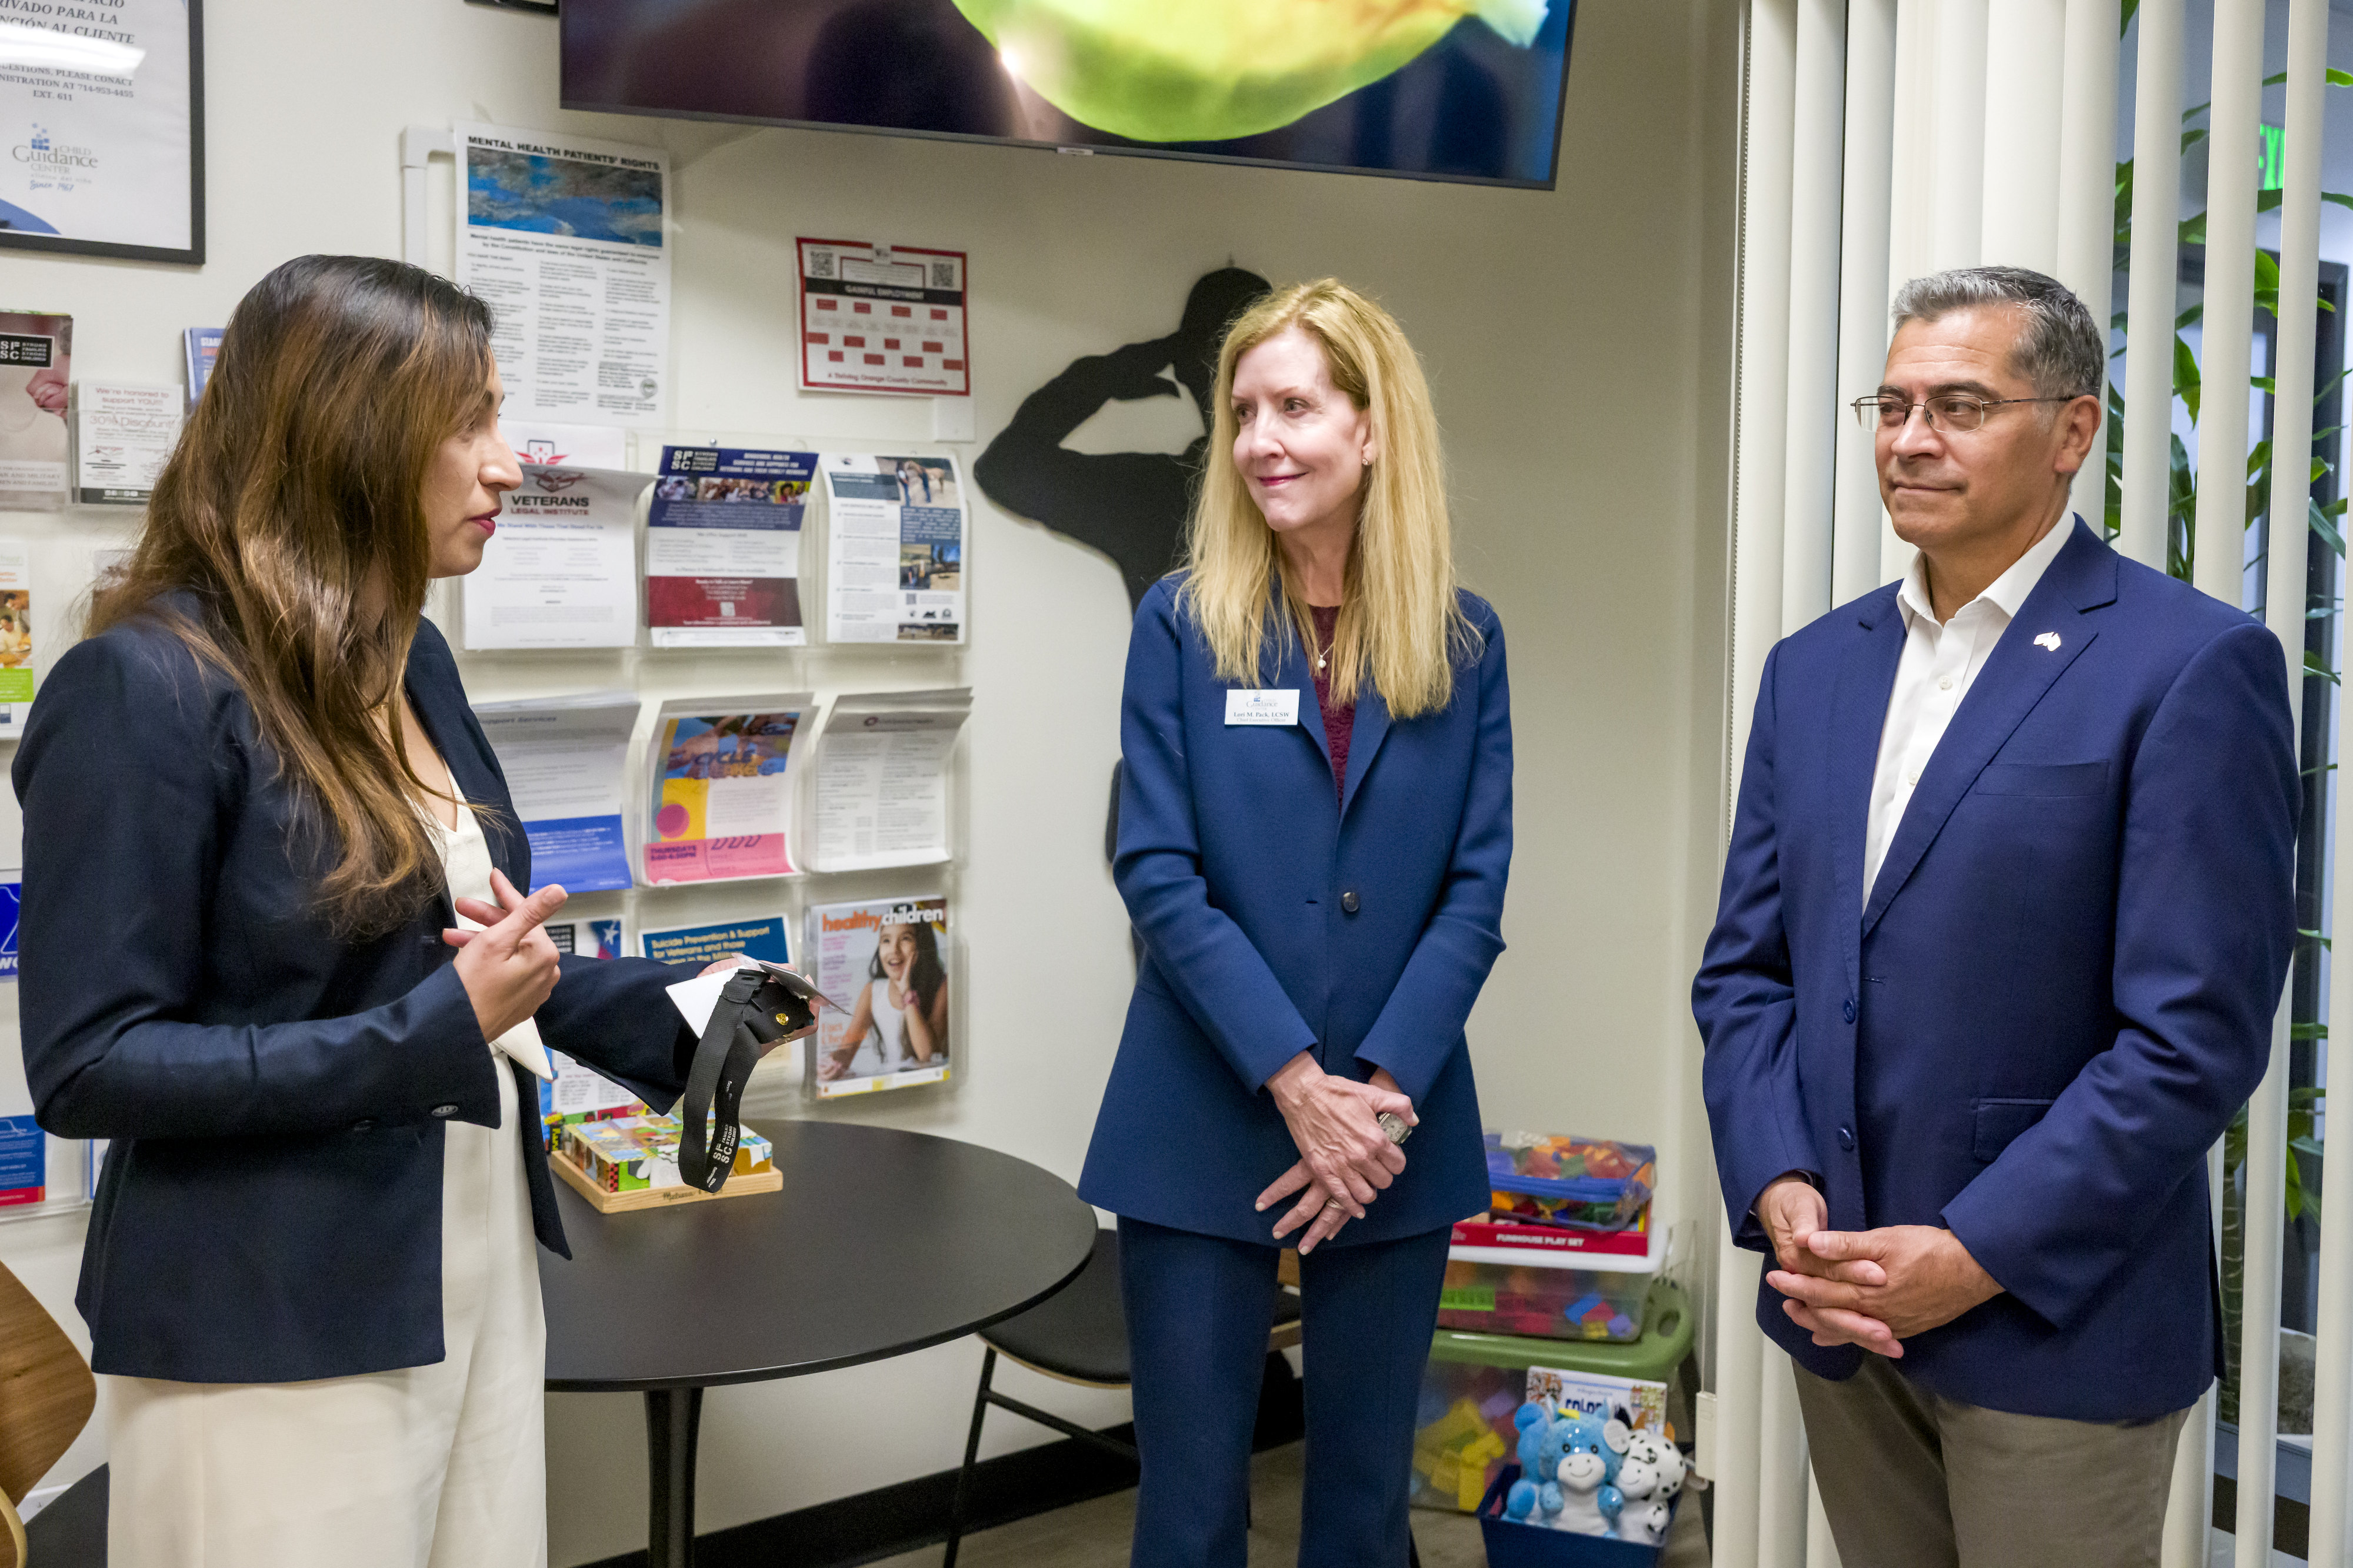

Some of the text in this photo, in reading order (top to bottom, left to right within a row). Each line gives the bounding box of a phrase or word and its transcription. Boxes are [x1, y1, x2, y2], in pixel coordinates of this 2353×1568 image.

[0, 0, 118, 24] RIVADO PARA LA
[75, 26, 135, 44] CLIENTE
[0, 63, 134, 86] UESTIONS, PLEASE CONACT
[0, 74, 59, 87] NISTRATION
[33, 90, 55, 99] EXT.
[12, 145, 98, 168] Guidance
[59, 145, 91, 155] CHILD
[468, 136, 660, 170] MENTAL HEALTH PATIENTS' RIGHTS
[31, 163, 70, 174] CENTER
[30, 180, 53, 190] Since
[0, 350, 19, 360] SC
[124, 389, 159, 398] honored
[671, 460, 691, 471] SC
[512, 496, 589, 506] VETERANS
[822, 906, 944, 932] healthy children
[652, 939, 683, 949] Suicide
[684, 932, 728, 944] Prevention
[737, 926, 769, 938] Support
[666, 946, 702, 957] Veterans
[704, 943, 722, 952] and
[713, 1143, 723, 1160] SF
[721, 1146, 732, 1164] SC
[1545, 1236, 1566, 1246] PLAY
[1568, 1237, 1585, 1247] SET
